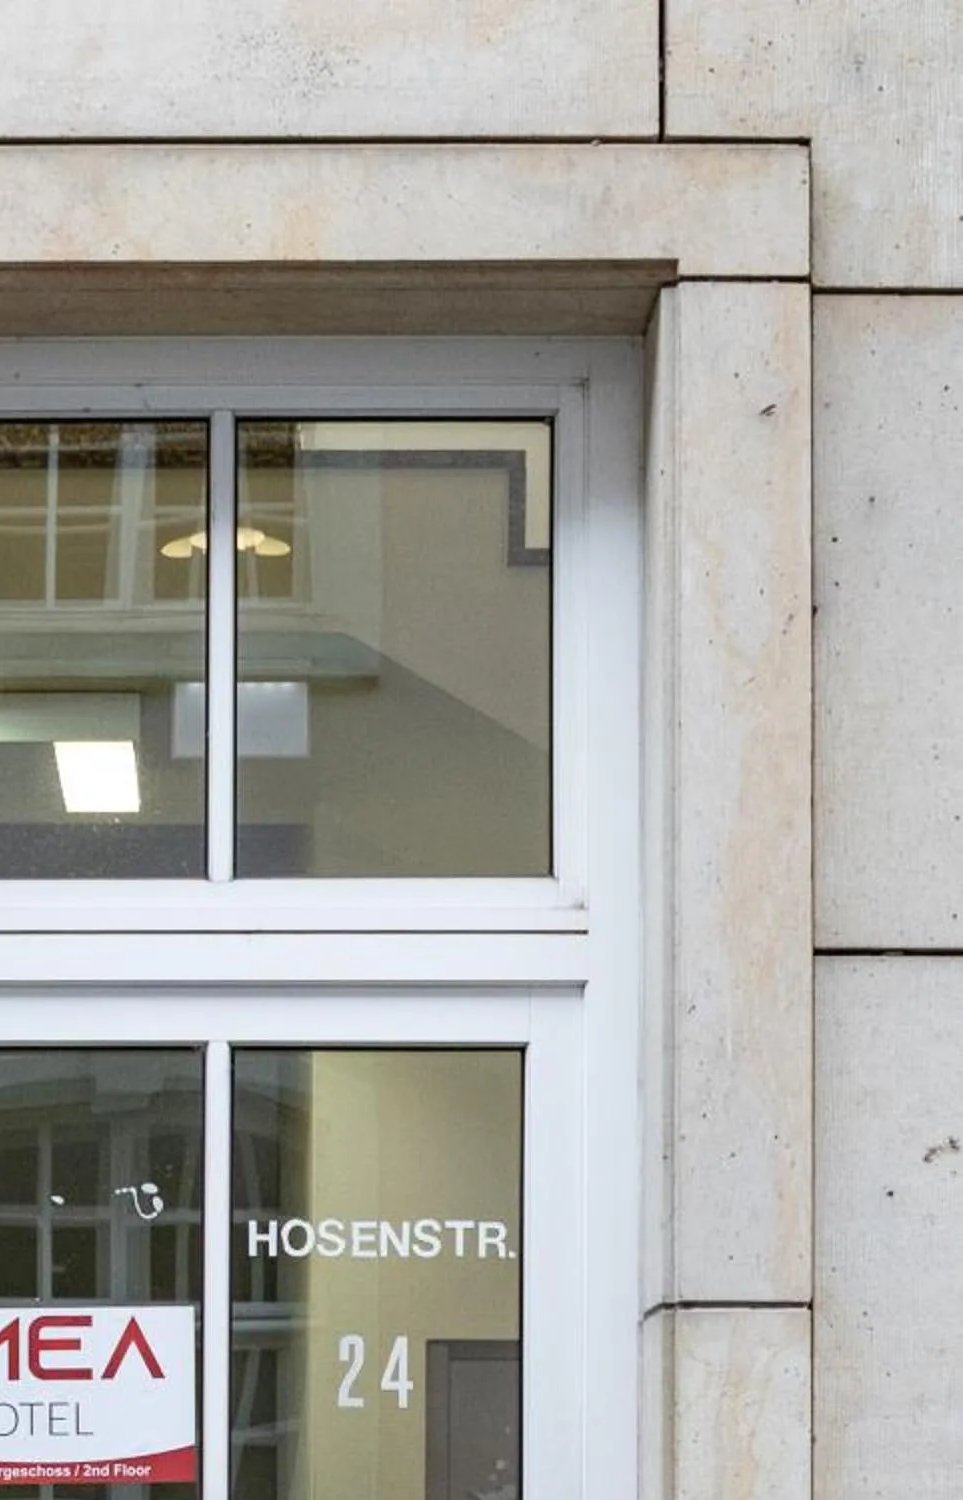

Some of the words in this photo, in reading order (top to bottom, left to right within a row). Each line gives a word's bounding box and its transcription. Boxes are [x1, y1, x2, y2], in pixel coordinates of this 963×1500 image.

[248, 1218, 517, 1260] HOSENSTR.
[83, 1464, 110, 1477] 2nd
[113, 1463, 152, 1478] Floor
